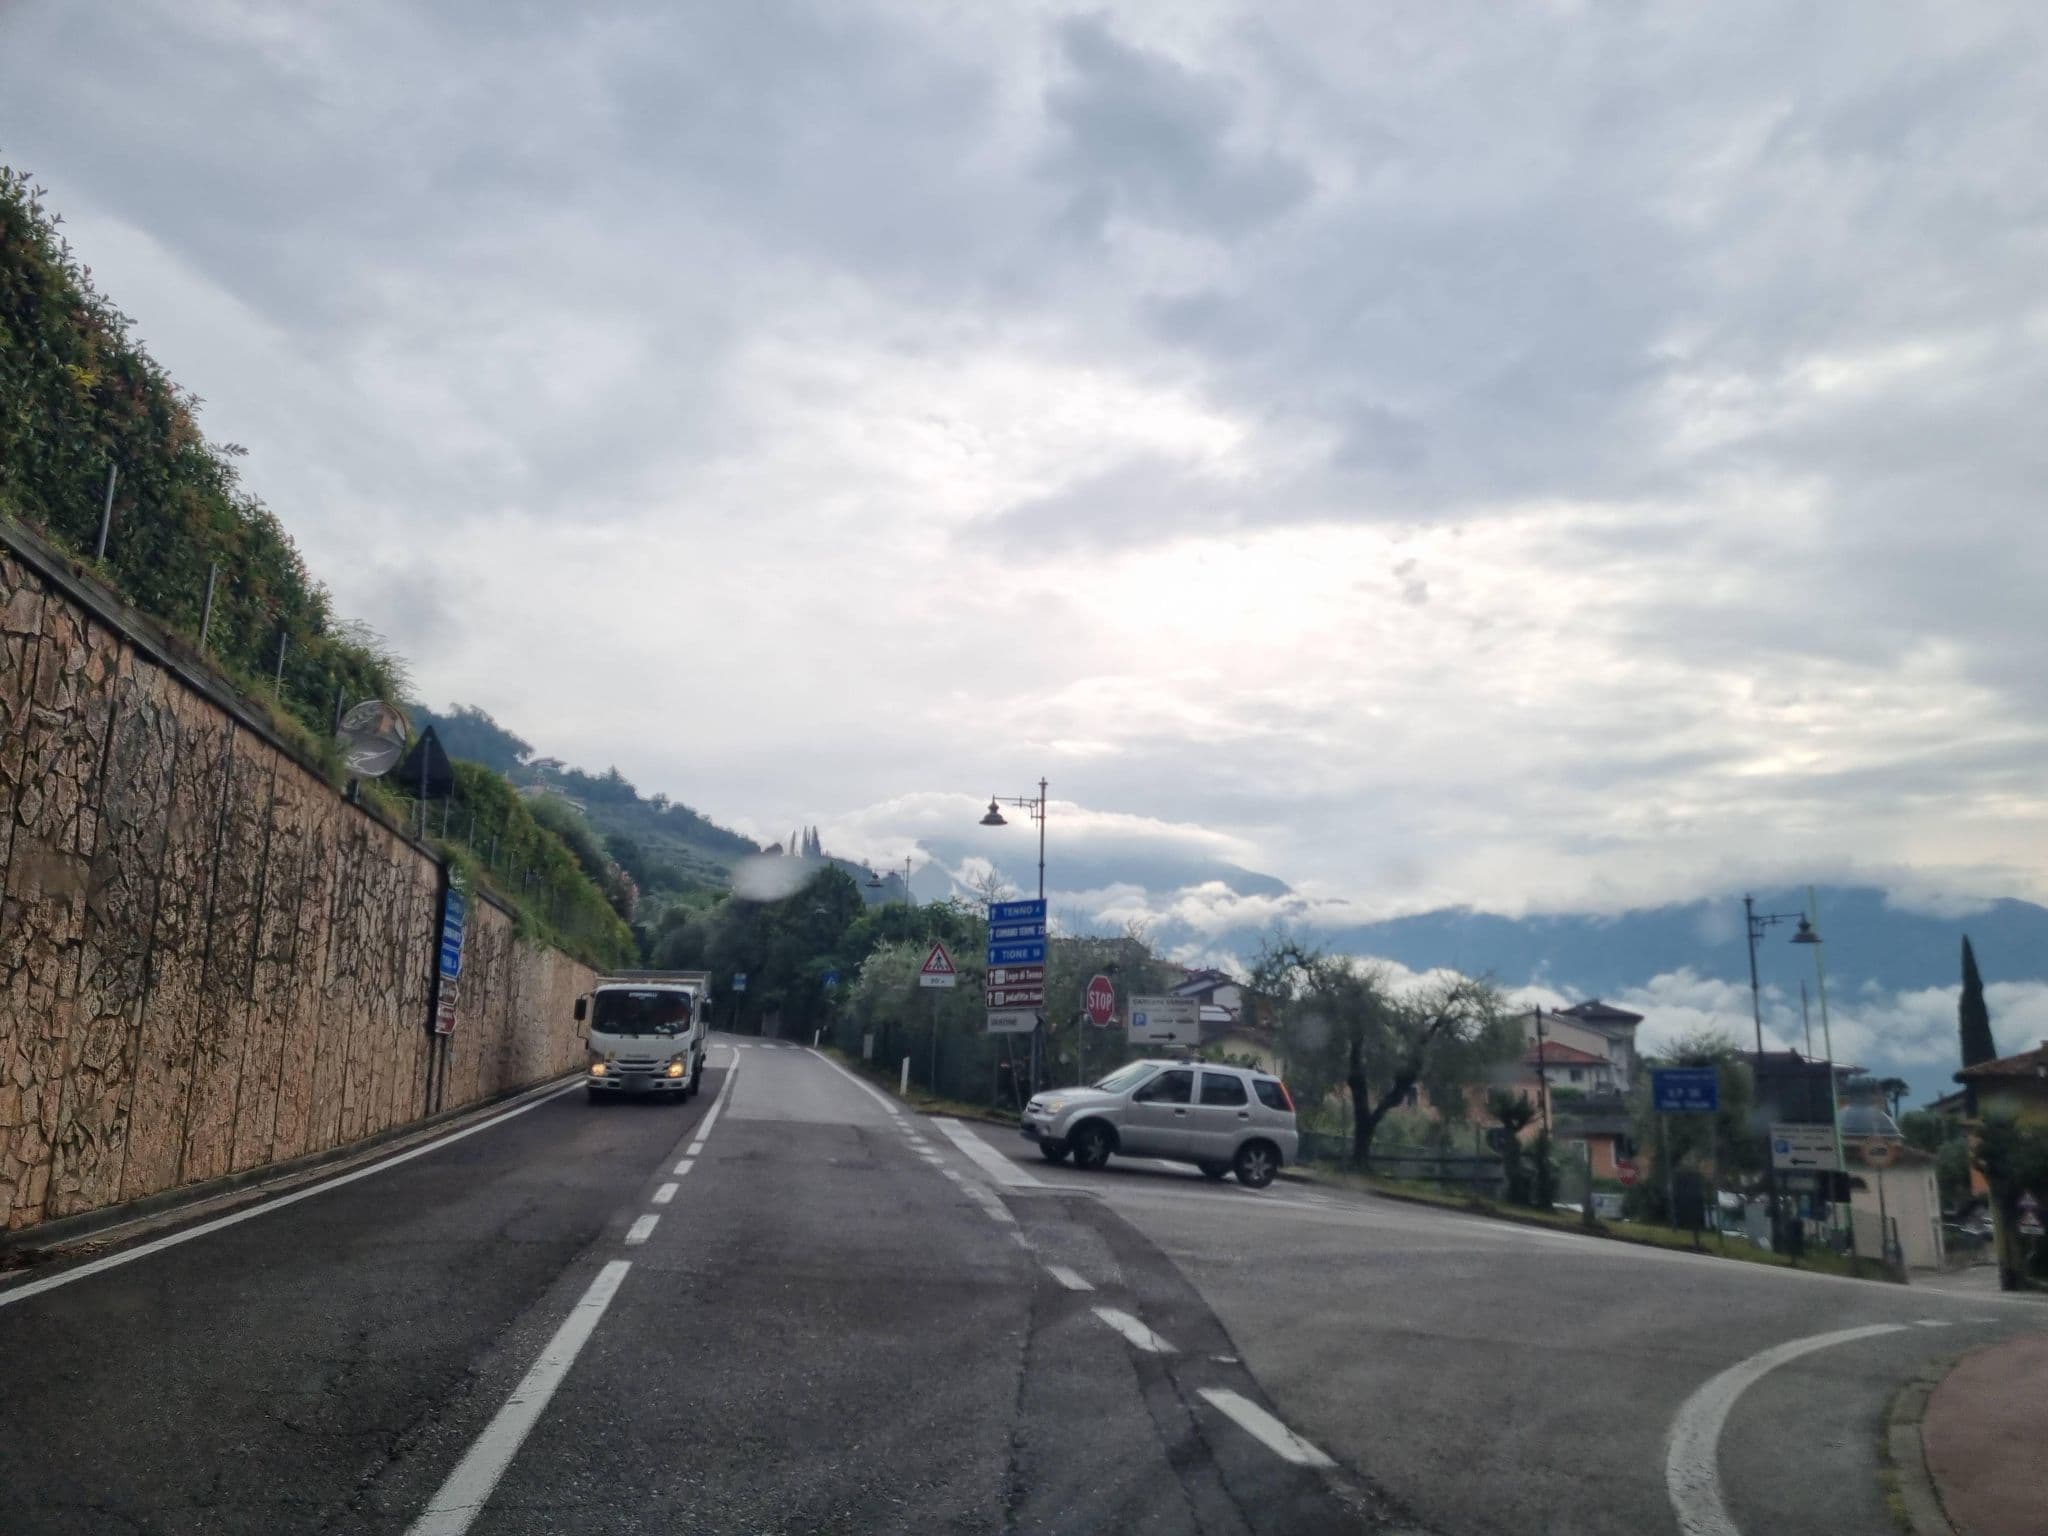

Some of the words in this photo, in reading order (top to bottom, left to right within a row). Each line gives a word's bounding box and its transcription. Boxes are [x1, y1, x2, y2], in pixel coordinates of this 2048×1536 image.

[1003, 905, 1033, 917] TENNO
[1003, 948, 1028, 960] TIONE
[1089, 991, 1112, 1011] STOP
